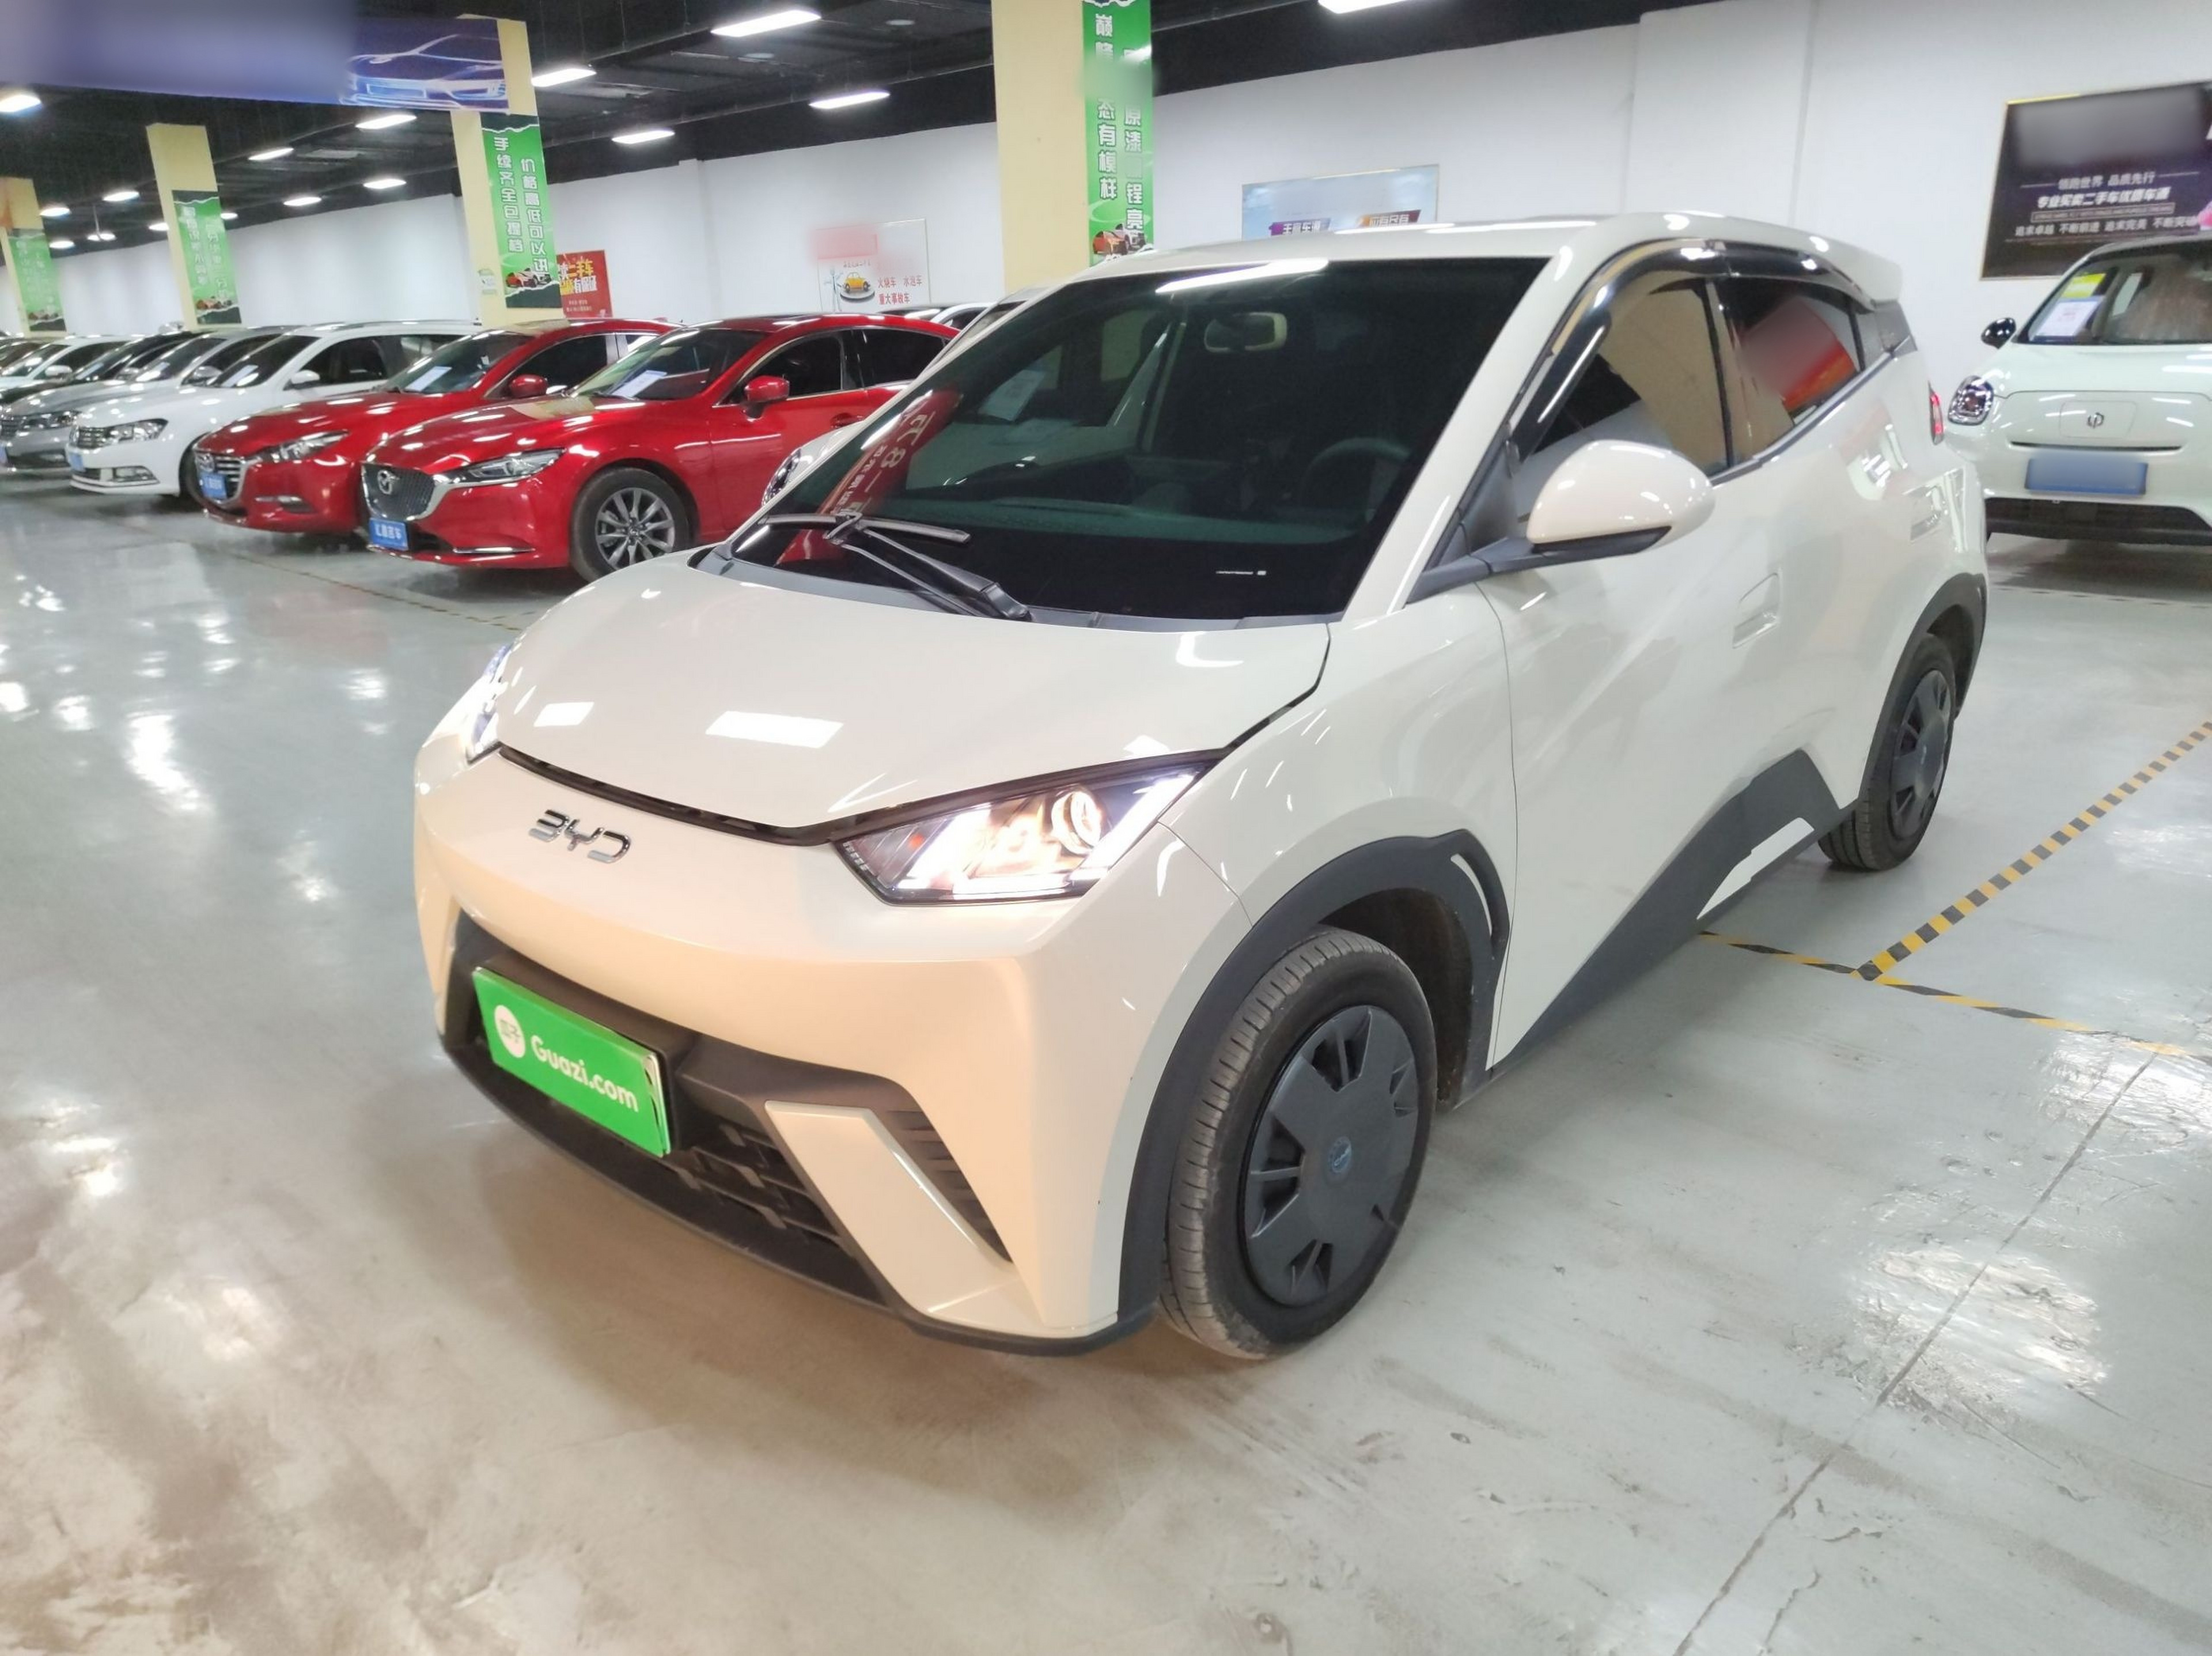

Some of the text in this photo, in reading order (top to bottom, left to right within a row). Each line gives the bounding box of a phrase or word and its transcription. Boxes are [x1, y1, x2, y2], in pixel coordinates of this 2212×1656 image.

[878, 293, 910, 305] 重大事故车
[528, 808, 632, 864] BYD
[531, 1035, 639, 1113] Guazi.com
